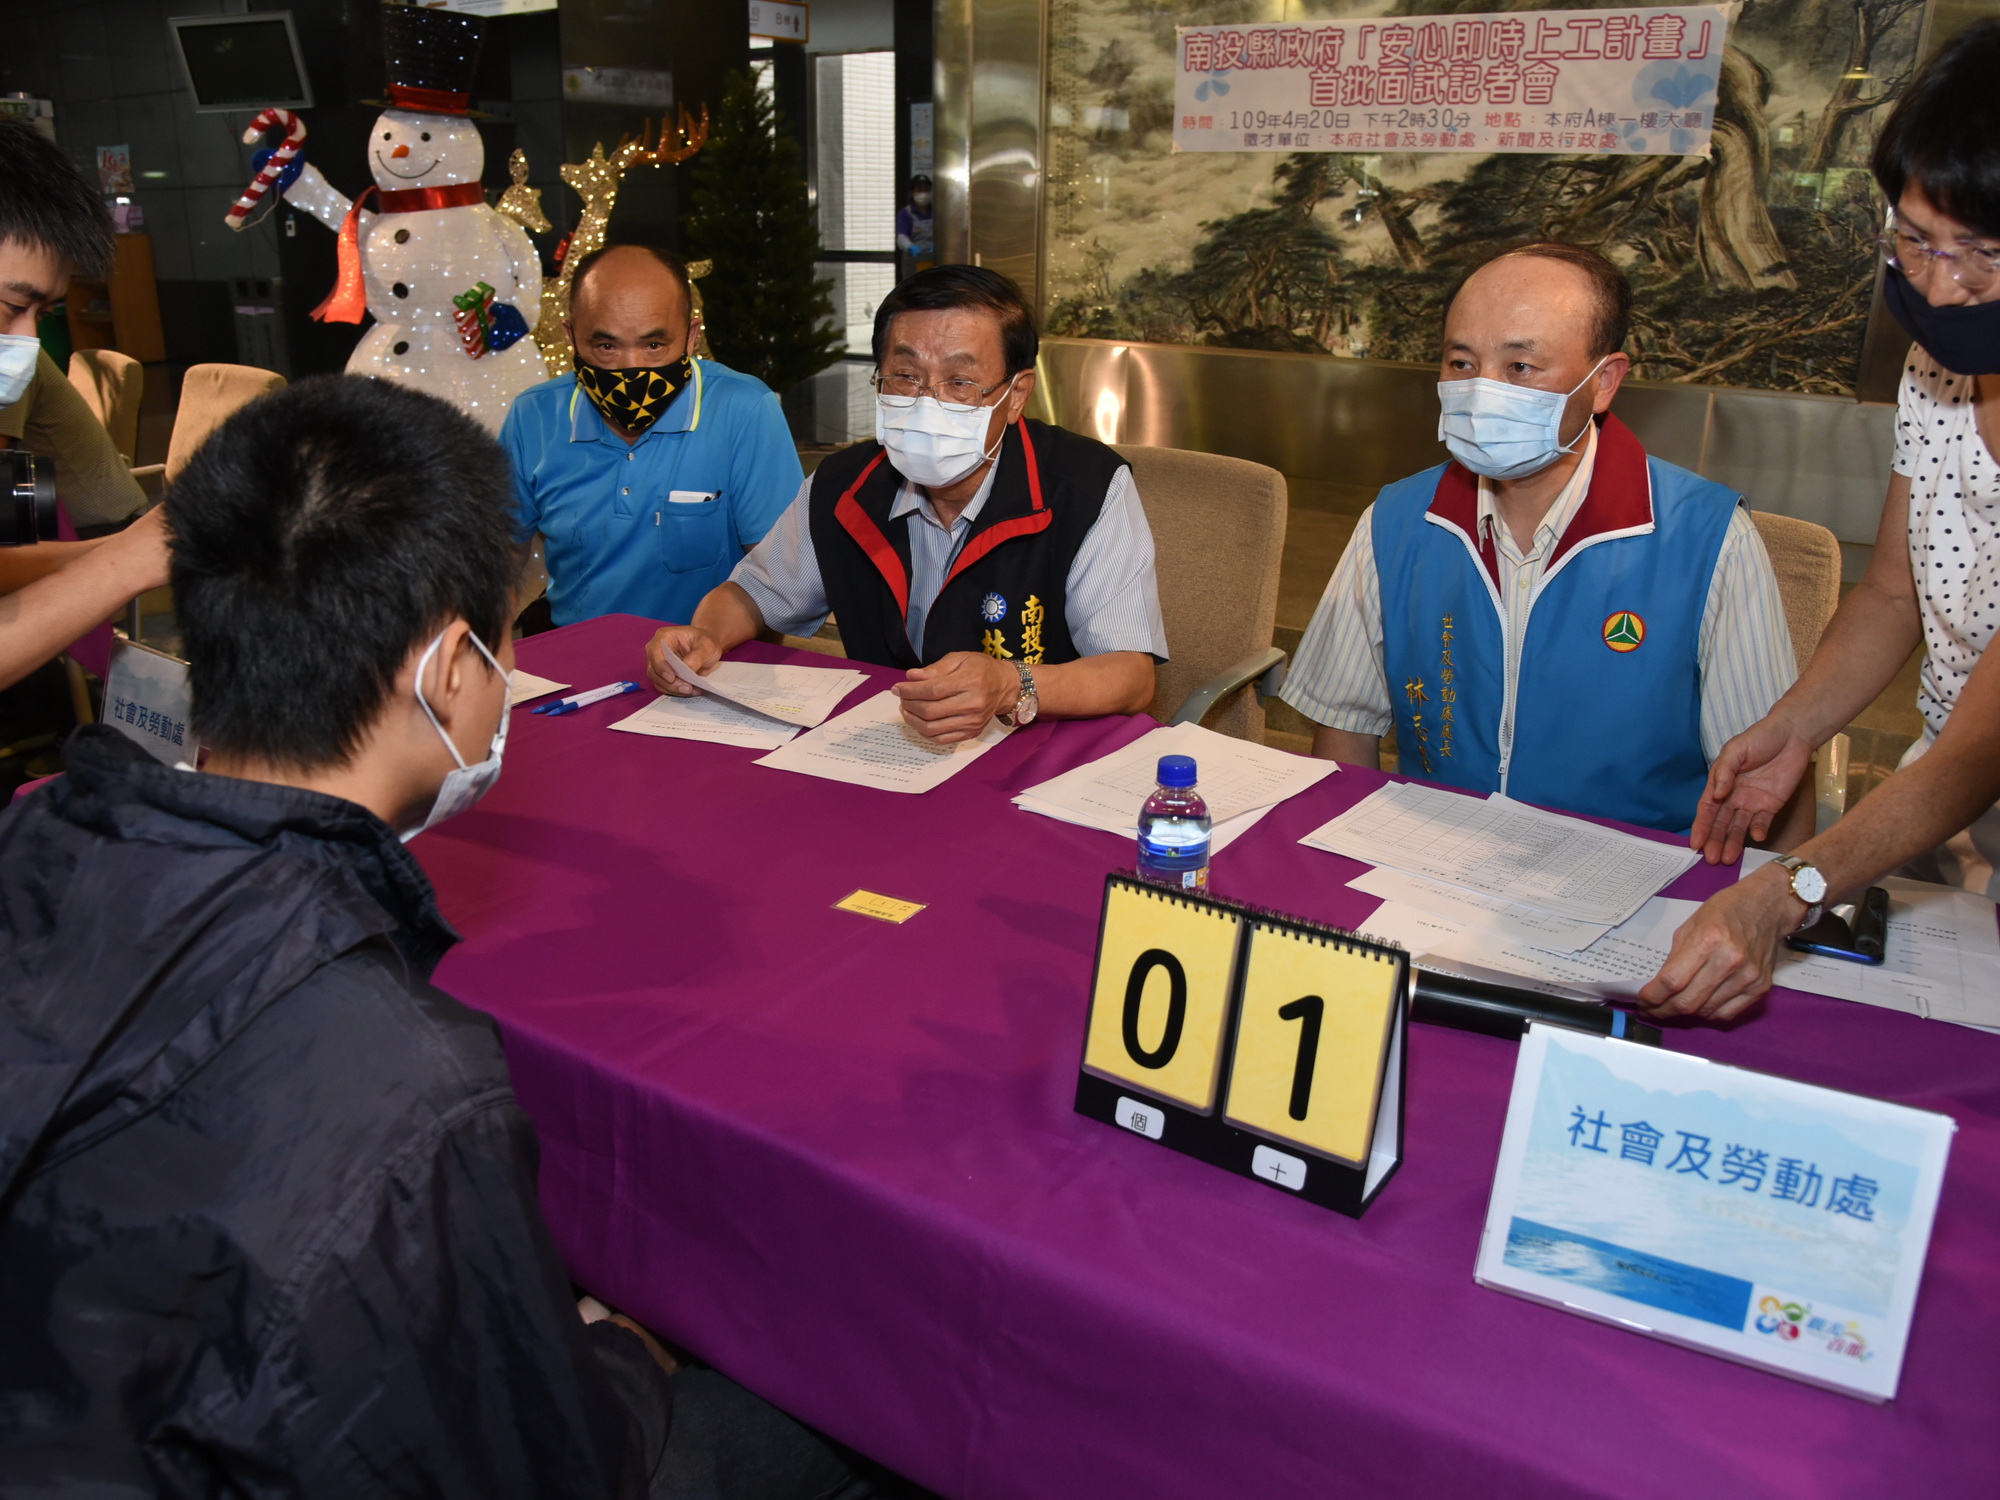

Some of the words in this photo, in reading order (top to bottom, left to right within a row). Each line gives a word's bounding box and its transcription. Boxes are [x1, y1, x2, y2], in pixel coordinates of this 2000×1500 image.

[1184, 14, 1711, 72] 南投縣政府「安心即時上工計畫」
[1309, 60, 1559, 107] 首批面試記者會
[114, 696, 185, 746] 社會及勞動處
[1130, 1111, 1148, 1132] 個
[1567, 1104, 1880, 1223] 社會及勞動處
